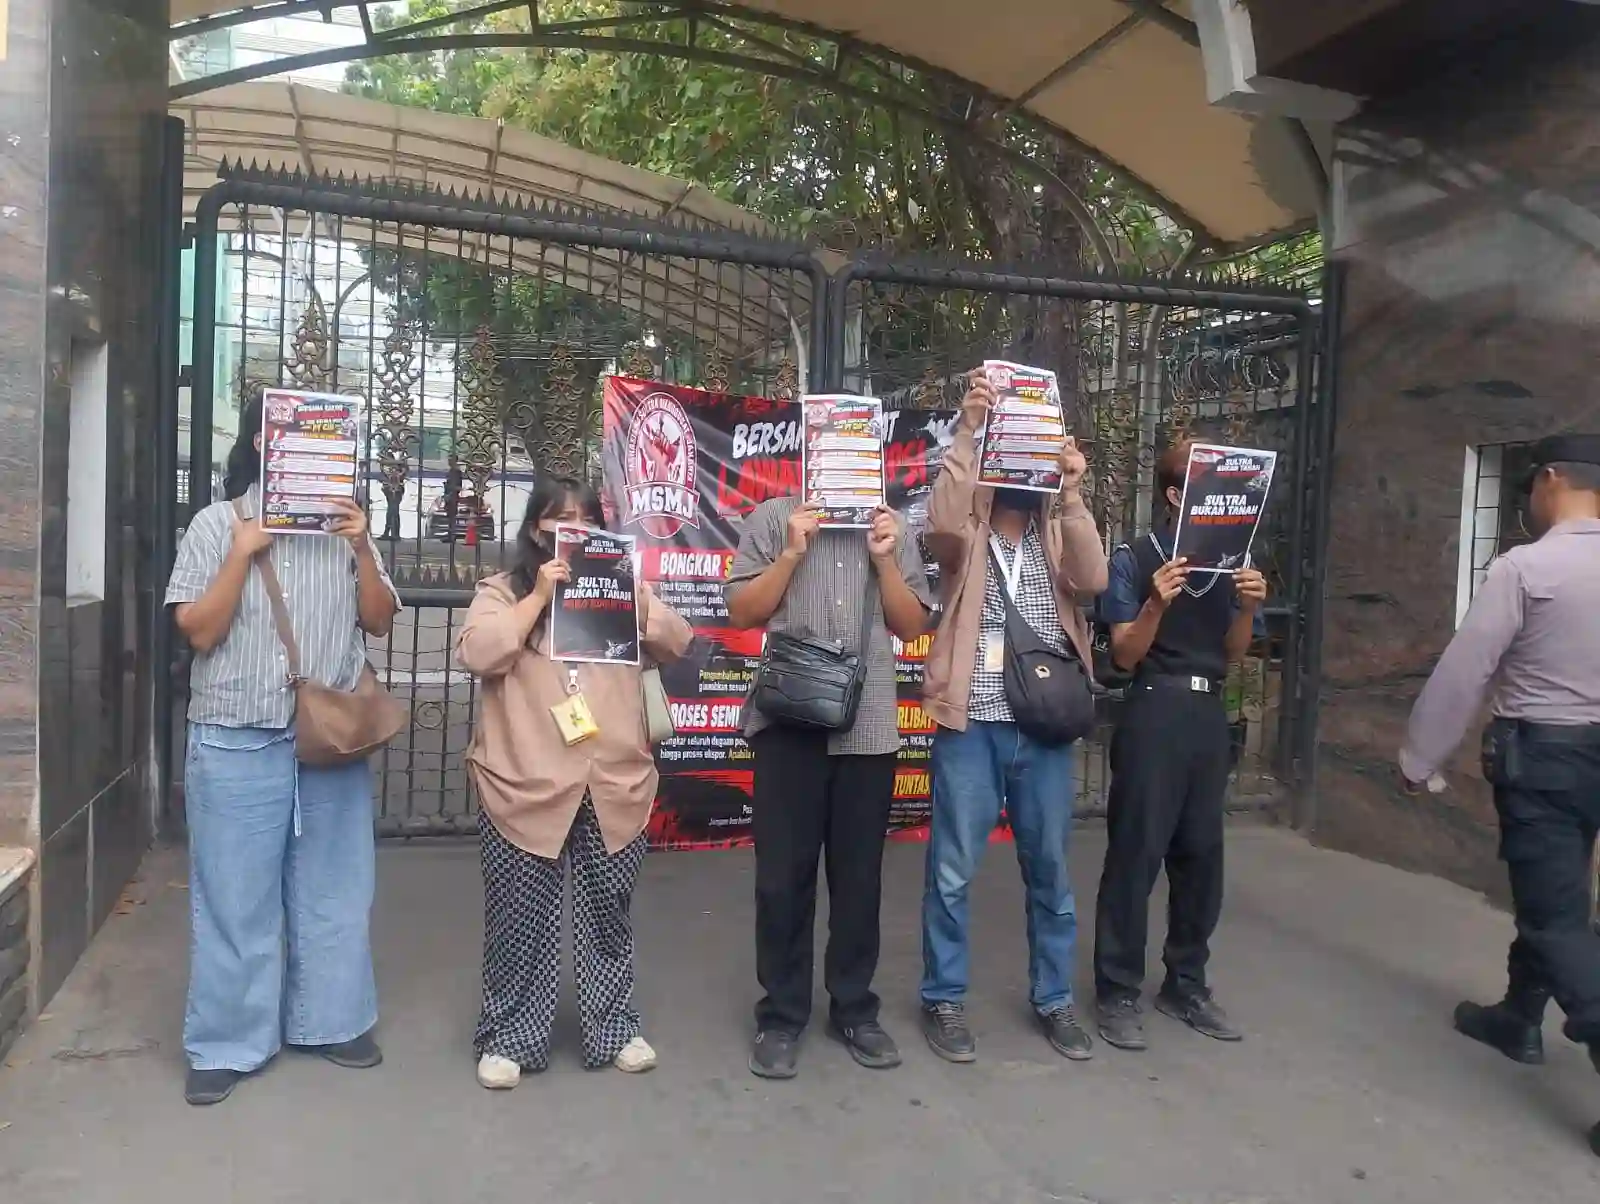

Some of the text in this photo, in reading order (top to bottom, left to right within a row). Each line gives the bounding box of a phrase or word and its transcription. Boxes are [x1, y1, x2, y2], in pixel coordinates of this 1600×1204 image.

[717, 456, 802, 513] LAWA
[631, 486, 695, 519] MSMJ
[1204, 494, 1247, 506] SULTRA
[1190, 505, 1258, 516] BUKAN TANAH
[660, 552, 722, 577] BONGKAR
[577, 576, 619, 589] SULTRA
[564, 588, 632, 601] BUKAN TANAH
[906, 634, 935, 656] ALIR
